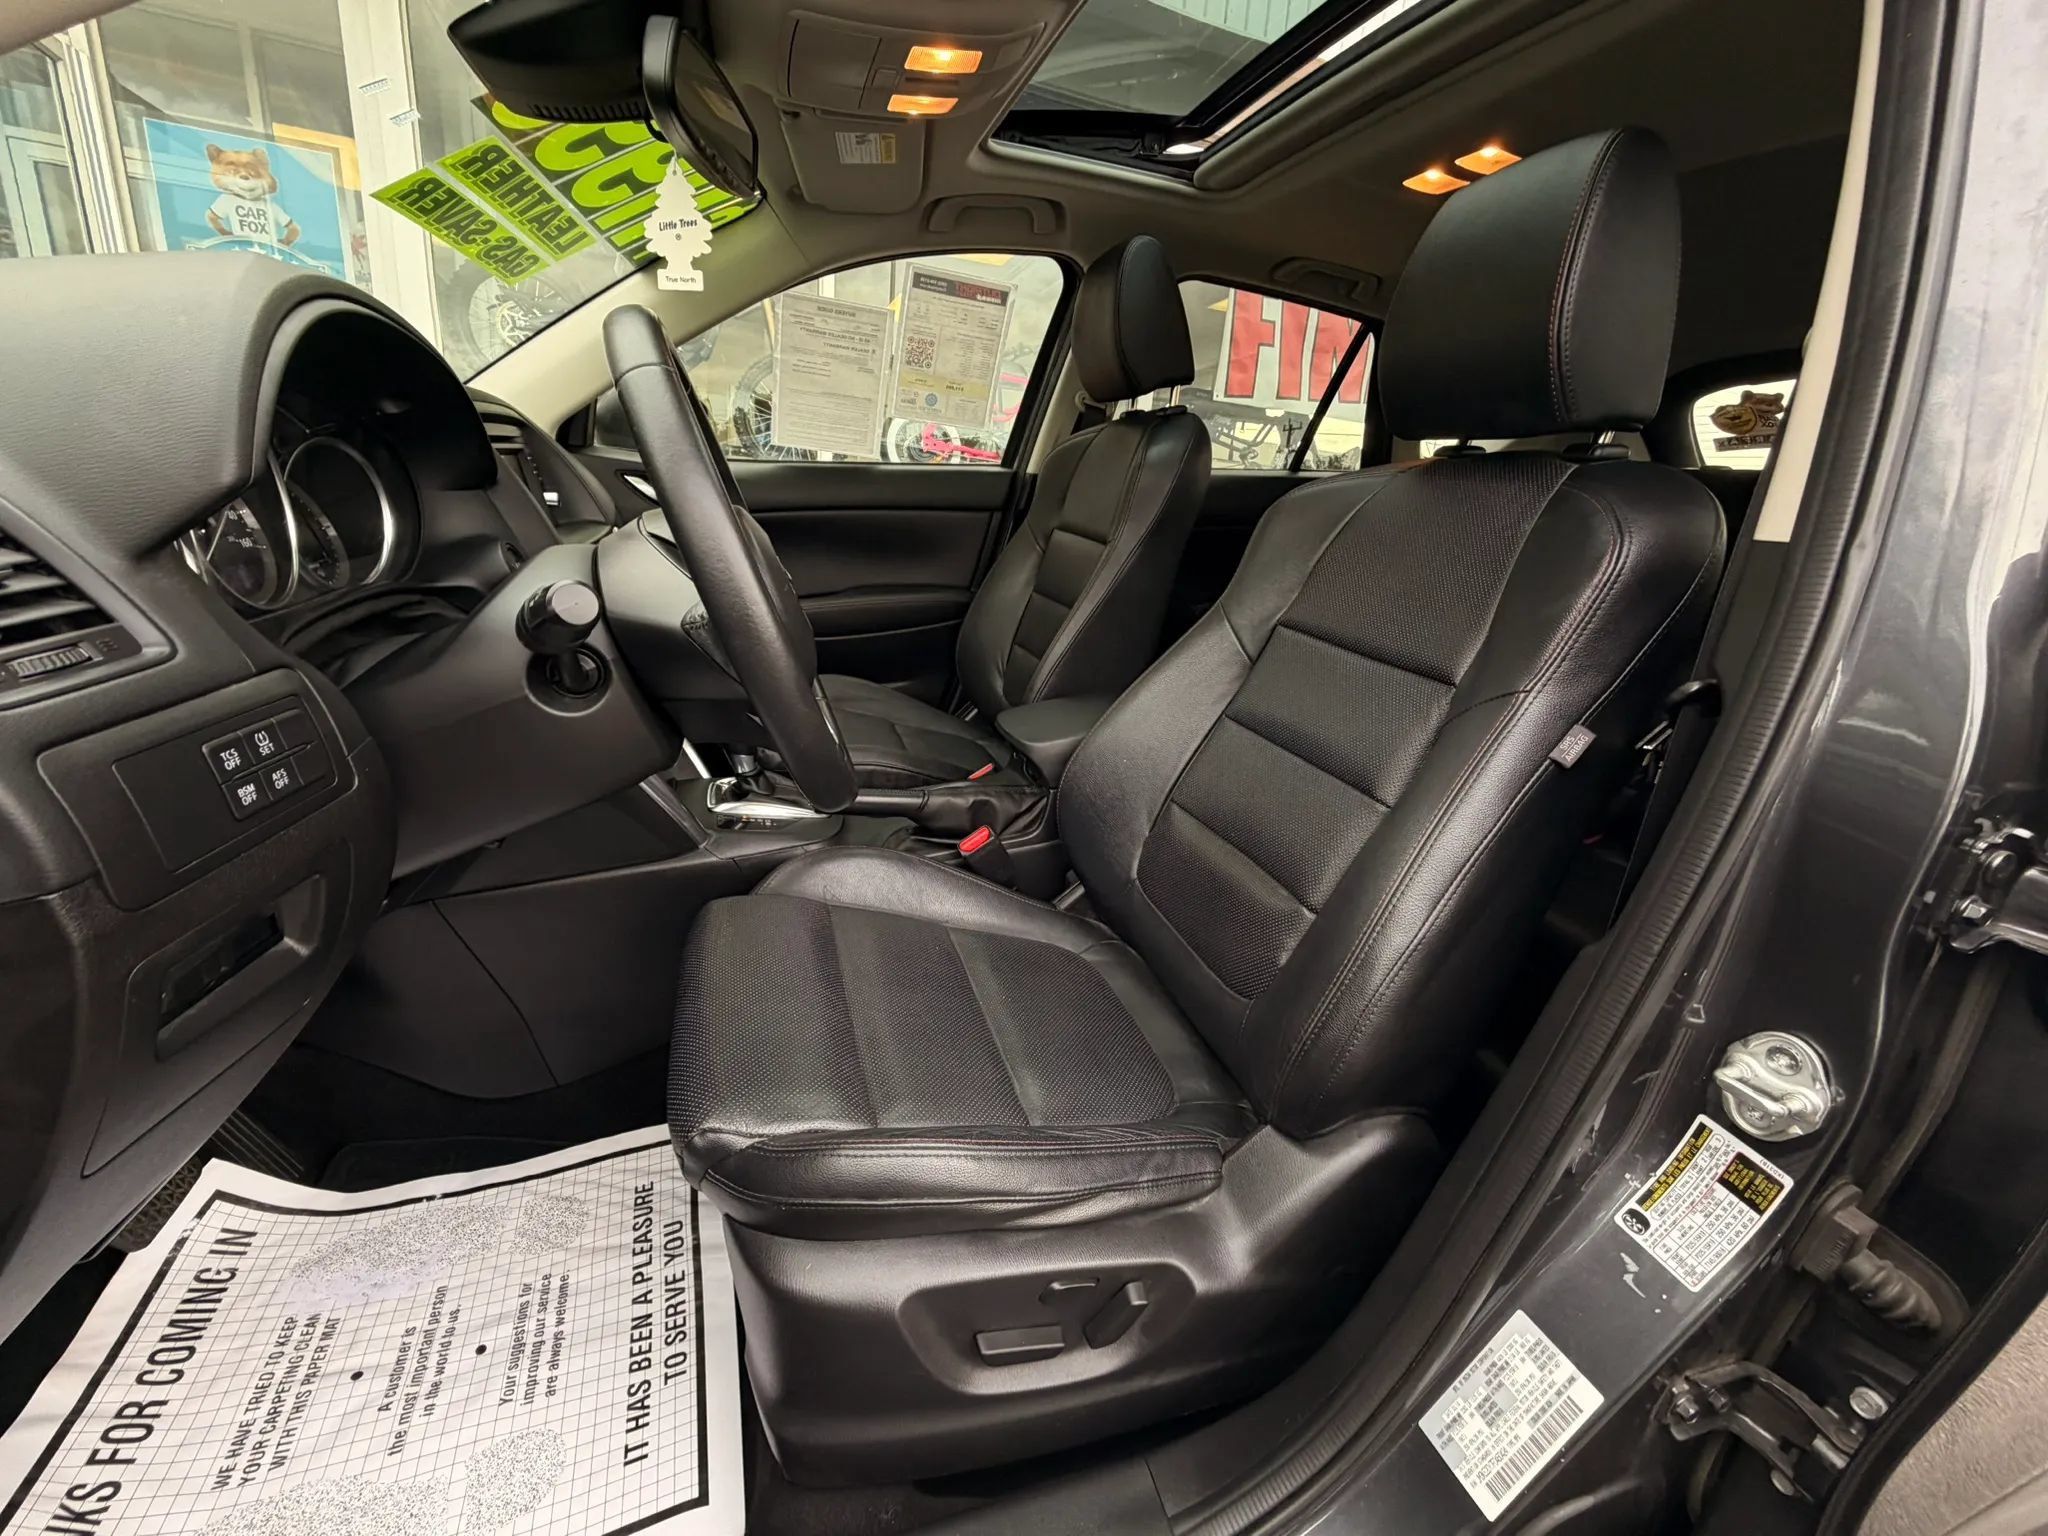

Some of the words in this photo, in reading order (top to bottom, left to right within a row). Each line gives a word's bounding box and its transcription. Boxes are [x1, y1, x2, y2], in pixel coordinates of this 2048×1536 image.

[235, 205, 268, 221] CAR
[659, 222, 677, 231] Little
[679, 219, 697, 228] Trees
[239, 220, 269, 235] FOX
[220, 748, 238, 761] TCS
[259, 743, 275, 756] SET
[1560, 735, 1576, 751] SRS
[1564, 735, 1590, 763] AIRBAG
[224, 757, 241, 770] OFF
[272, 768, 287, 781] AFS
[237, 783, 255, 797] BSM
[274, 777, 289, 789] OFF
[241, 792, 258, 806] OFF
[632, 1181, 654, 1287] PLEASURE
[663, 1220, 684, 1267] YOU
[428, 1285, 448, 1326] person
[537, 1273, 552, 1314] service
[554, 1269, 570, 1328] welcome.
[631, 1288, 653, 1307] A
[450, 1304, 462, 1323] us.
[664, 1269, 687, 1347] SERVE
[401, 1326, 417, 1338] is
[444, 1326, 456, 1339] to
[534, 1318, 546, 1338] our
[85, 1400, 170, 1466] FOR
[135, 1266, 239, 1386] COMING
[209, 1227, 258, 1256] IN
[498, 1375, 517, 1406] Your
[508, 1300, 530, 1371] suggestions
[520, 1282, 532, 1298] for
[546, 1330, 566, 1372] always
[628, 1312, 653, 1374] BEEN
[384, 1341, 412, 1399] customer
[406, 1328, 436, 1388] important
[434, 1340, 452, 1377] world
[664, 1352, 687, 1386] TO
[520, 1340, 546, 1406] improving
[268, 1427, 297, 1472] WITH
[286, 1389, 312, 1427] THIS
[300, 1345, 330, 1386] PAPER
[320, 1317, 341, 1342] MAT
[424, 1379, 442, 1399] the
[545, 1375, 558, 1398] are
[211, 1462, 237, 1490] WE
[225, 1418, 257, 1460] HAVE
[244, 1371, 275, 1415] TRIED
[264, 1350, 284, 1369] TO
[274, 1316, 298, 1348] KEEP
[237, 1437, 271, 1488] YOUR
[259, 1354, 305, 1435] CARPETING
[295, 1313, 322, 1351] CLEAN
[378, 1401, 393, 1412] A
[399, 1392, 417, 1424] most
[419, 1402, 436, 1418] in
[625, 1378, 652, 1435] HAS
[387, 1431, 407, 1456] the
[623, 1442, 649, 1467] IT
